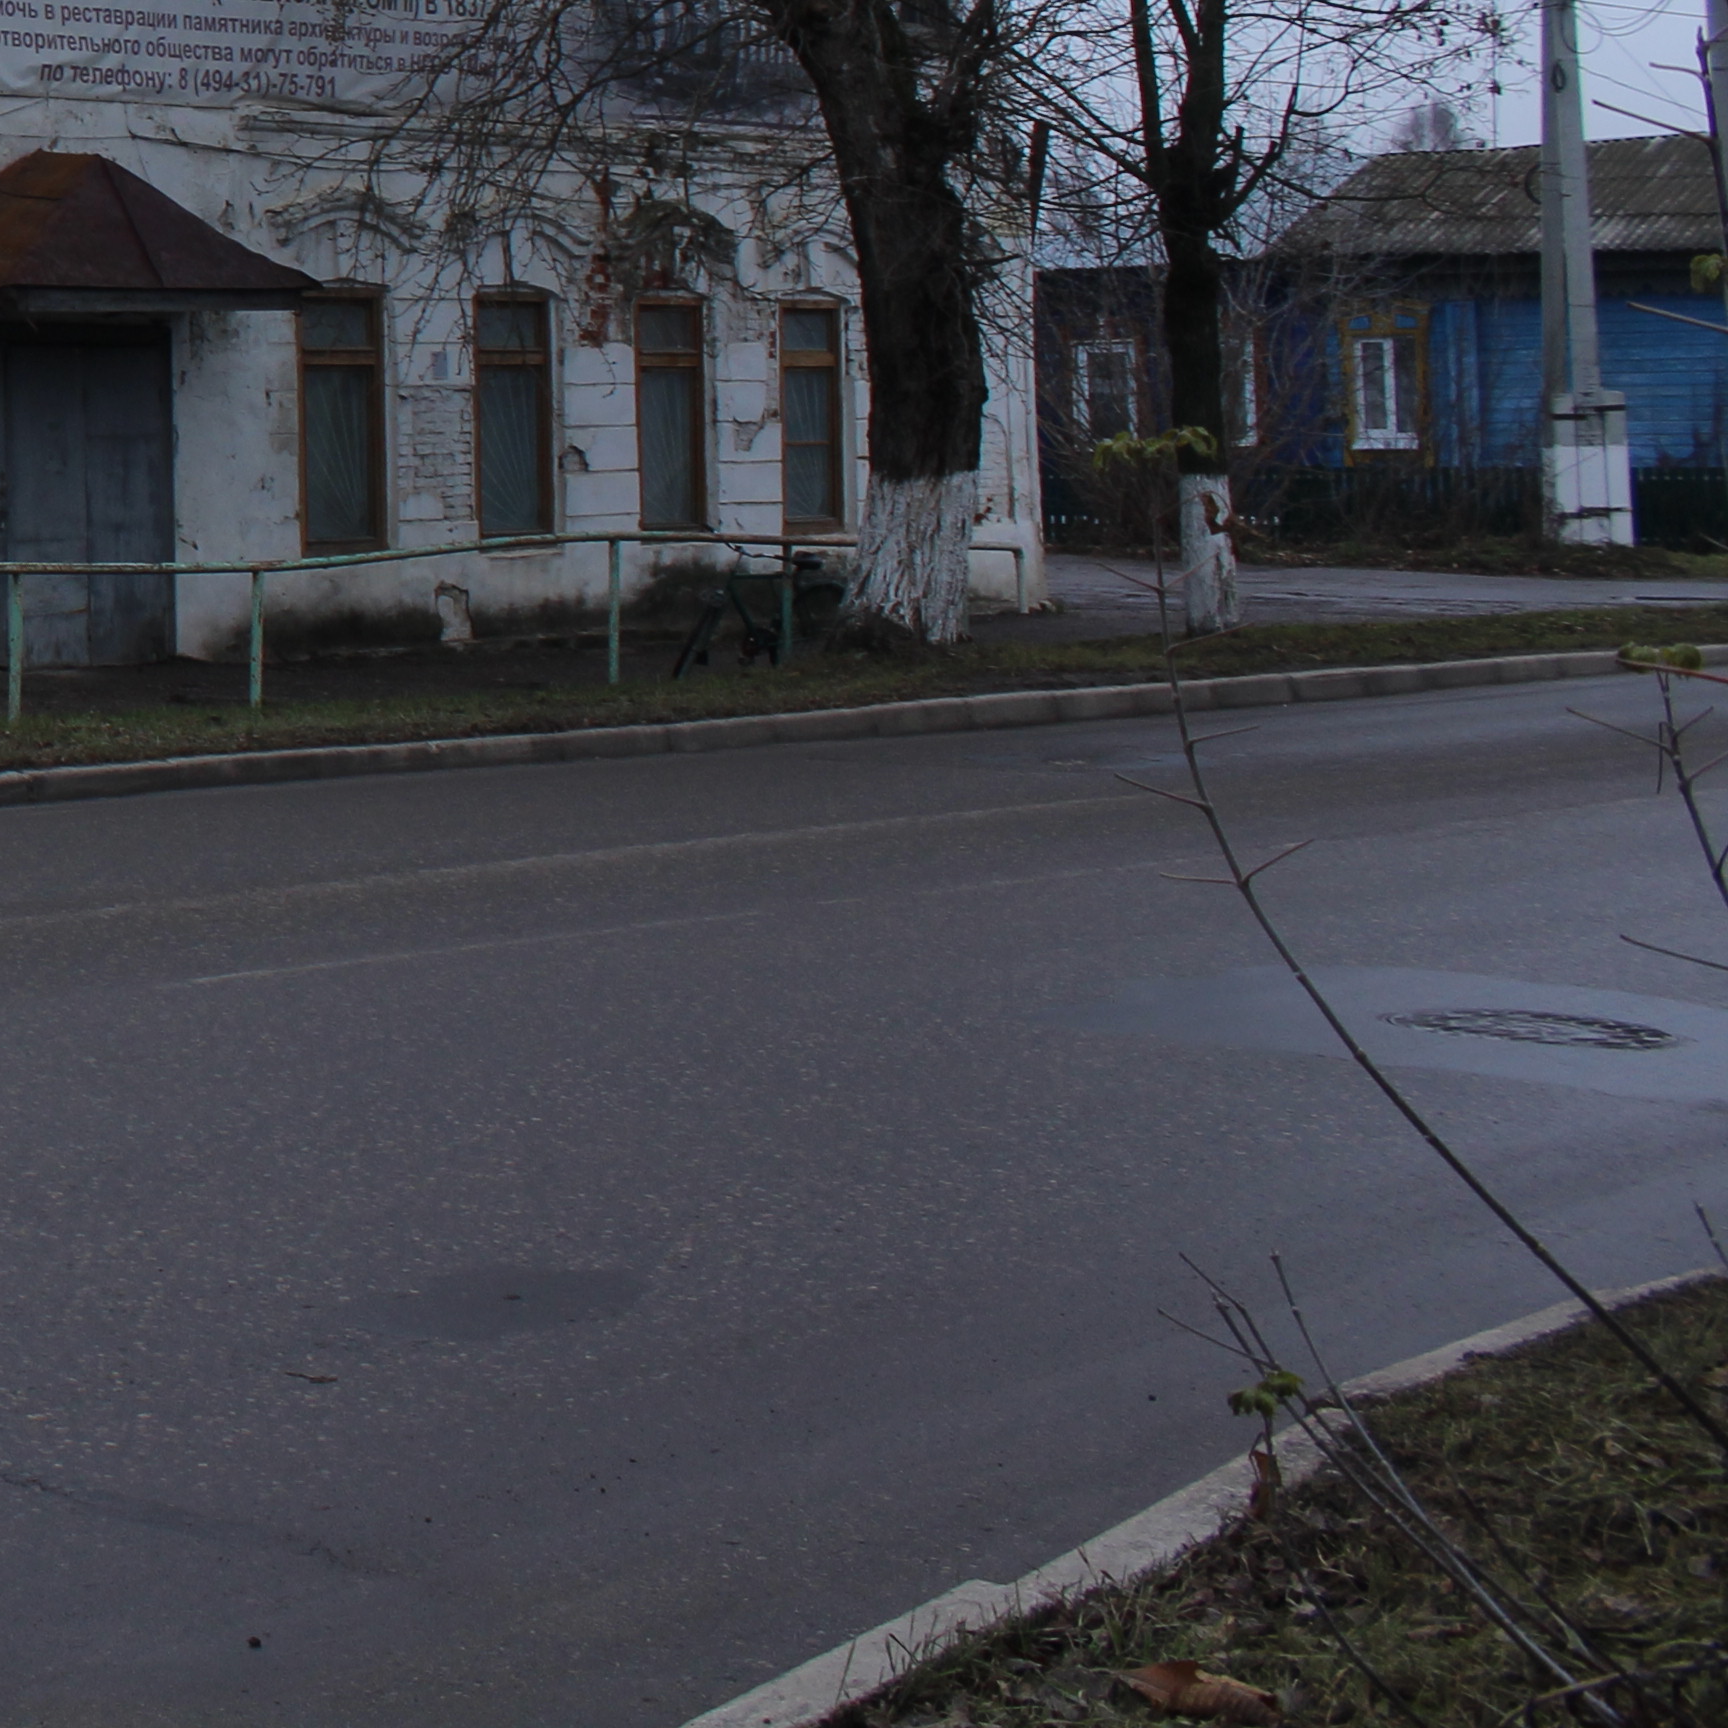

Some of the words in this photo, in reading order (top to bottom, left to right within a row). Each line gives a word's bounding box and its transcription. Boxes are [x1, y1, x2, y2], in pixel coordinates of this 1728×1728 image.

[45, 2, 56, 21] в
[61, 4, 177, 31] реставрации
[182, 14, 284, 36] памятника
[399, 28, 409, 45] и
[146, 36, 234, 62] общества
[239, 46, 293, 69] могут
[297, 48, 394, 73] обратиться
[39, 63, 65, 83] по
[70, 64, 172, 95] телефону:
[178, 66, 189, 91] 8
[194, 68, 337, 99] (494-31)-75-791
